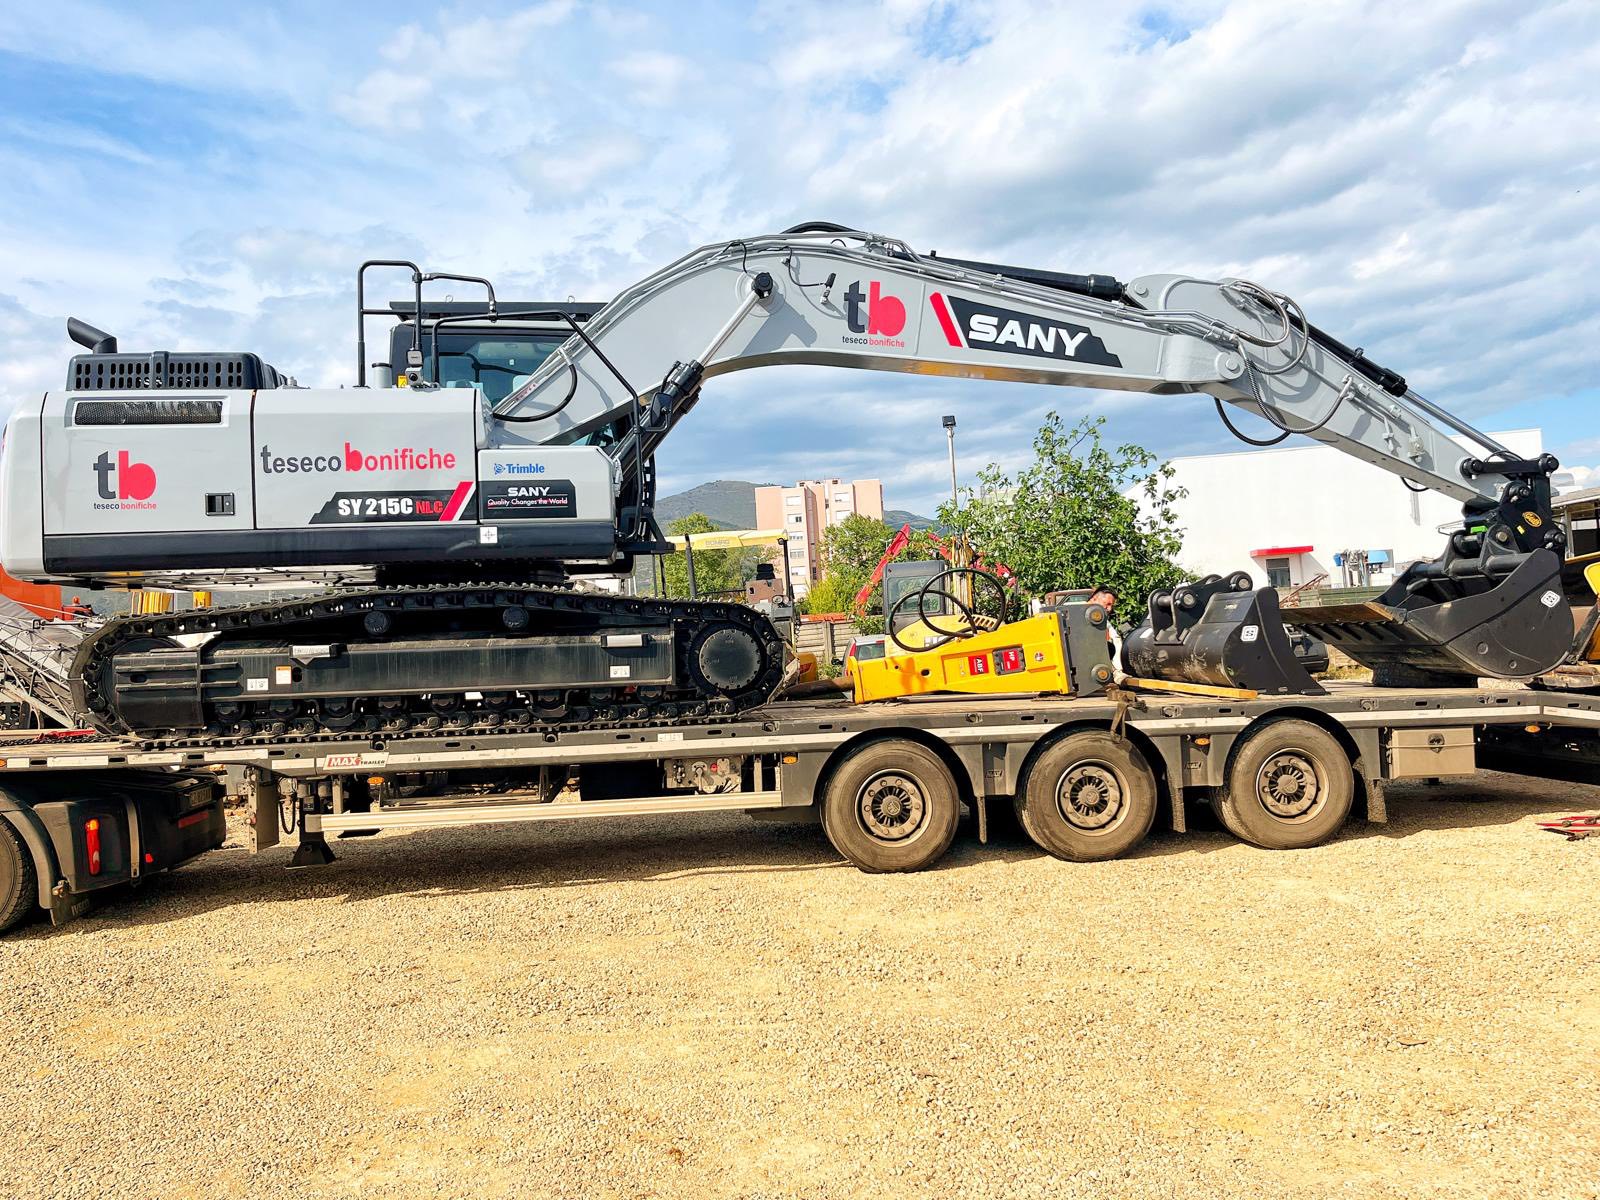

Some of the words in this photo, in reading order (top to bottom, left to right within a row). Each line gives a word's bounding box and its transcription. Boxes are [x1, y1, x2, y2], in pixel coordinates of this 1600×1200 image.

[843, 280, 906, 337] tb
[842, 335, 868, 345] teseco
[869, 337, 905, 348] bonifiche
[968, 313, 1089, 357] SANY
[260, 444, 342, 474] teseco
[344, 442, 456, 472] bonifiche
[93, 450, 157, 500] tb
[506, 463, 545, 474] Trimble
[507, 486, 550, 497] SANY
[93, 502, 120, 510] teseco
[121, 502, 157, 510] bonifiche
[338, 499, 363, 516] SY
[365, 498, 413, 515] 215C
[415, 501, 444, 514] NLC
[487, 499, 510, 507] Quality
[511, 498, 537, 507] Changes
[549, 497, 568, 505] World
[329, 757, 359, 767] MAX
